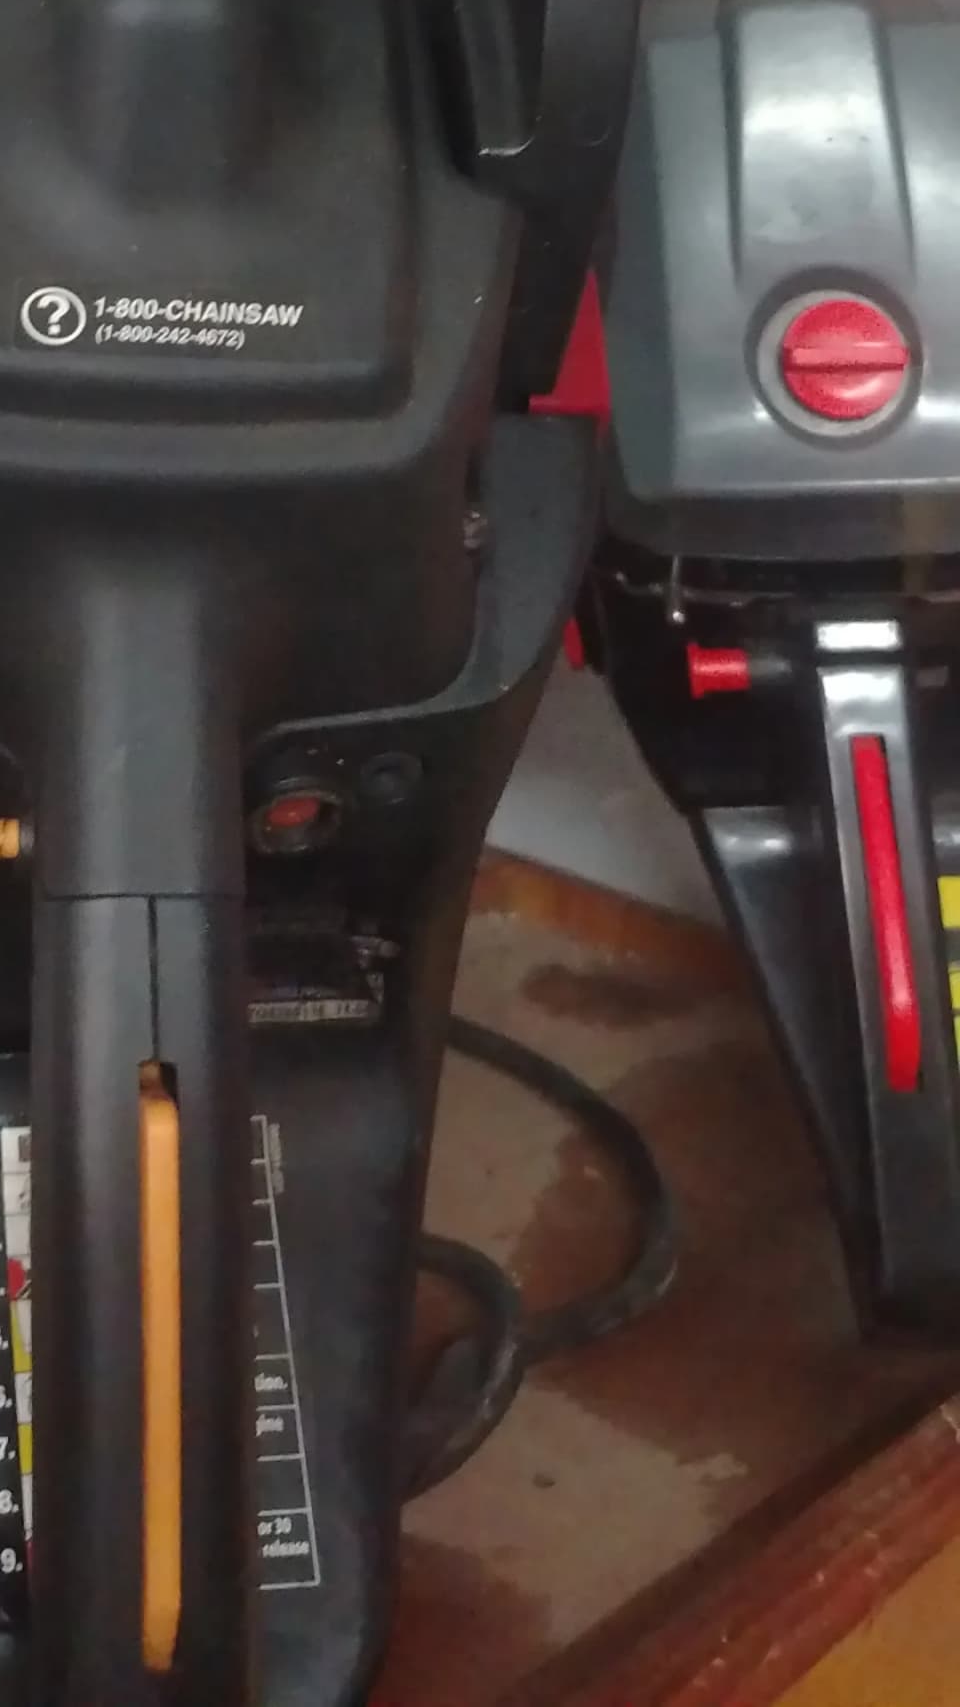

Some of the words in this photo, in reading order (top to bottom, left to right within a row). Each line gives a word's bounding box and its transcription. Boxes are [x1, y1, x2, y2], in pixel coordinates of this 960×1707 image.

[93, 296, 304, 327] 1-800-CHAINSAW
[95, 324, 245, 350] (1-800-242-4672)
[0, 1548, 23, 1573] 9.
